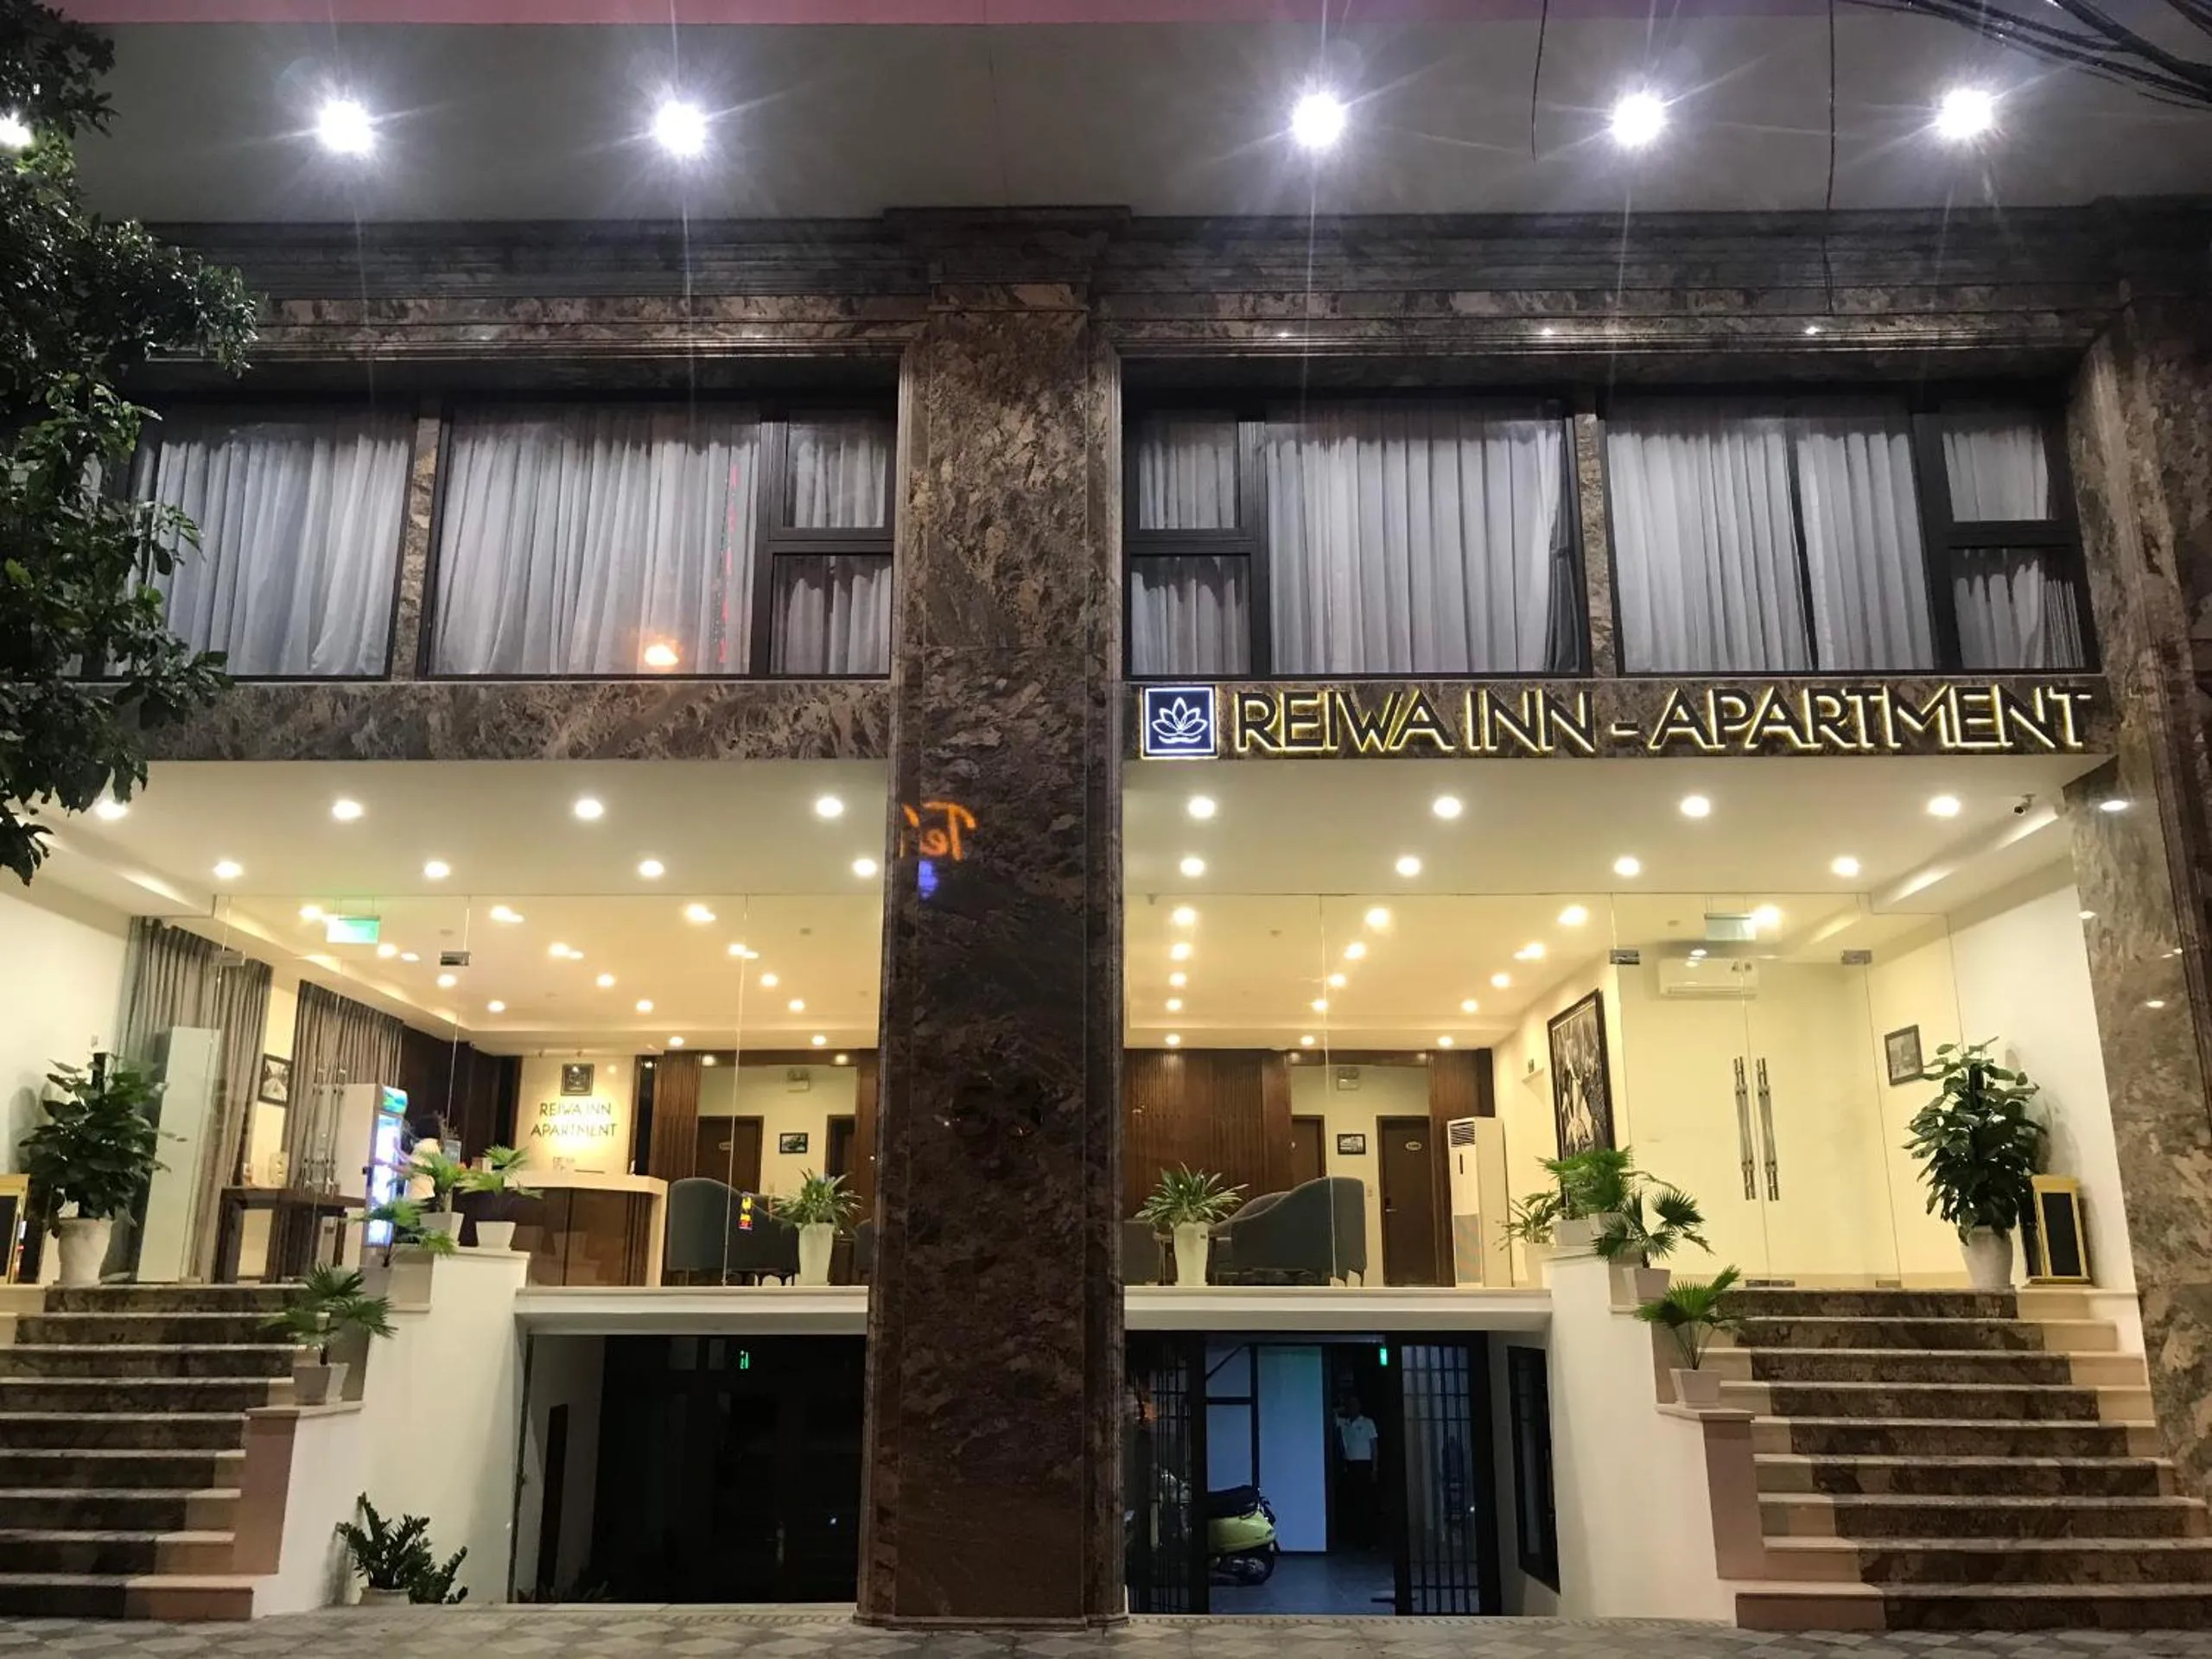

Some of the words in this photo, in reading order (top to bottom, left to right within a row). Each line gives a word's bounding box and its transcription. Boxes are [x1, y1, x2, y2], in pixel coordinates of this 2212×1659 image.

[1234, 689, 1455, 751] REIWA
[1466, 689, 1596, 753] INN
[1648, 685, 2094, 749] APARTMENT
[539, 1102, 581, 1116] REIWA
[586, 1102, 612, 1116] INN
[531, 1123, 617, 1138] APARTMENT
